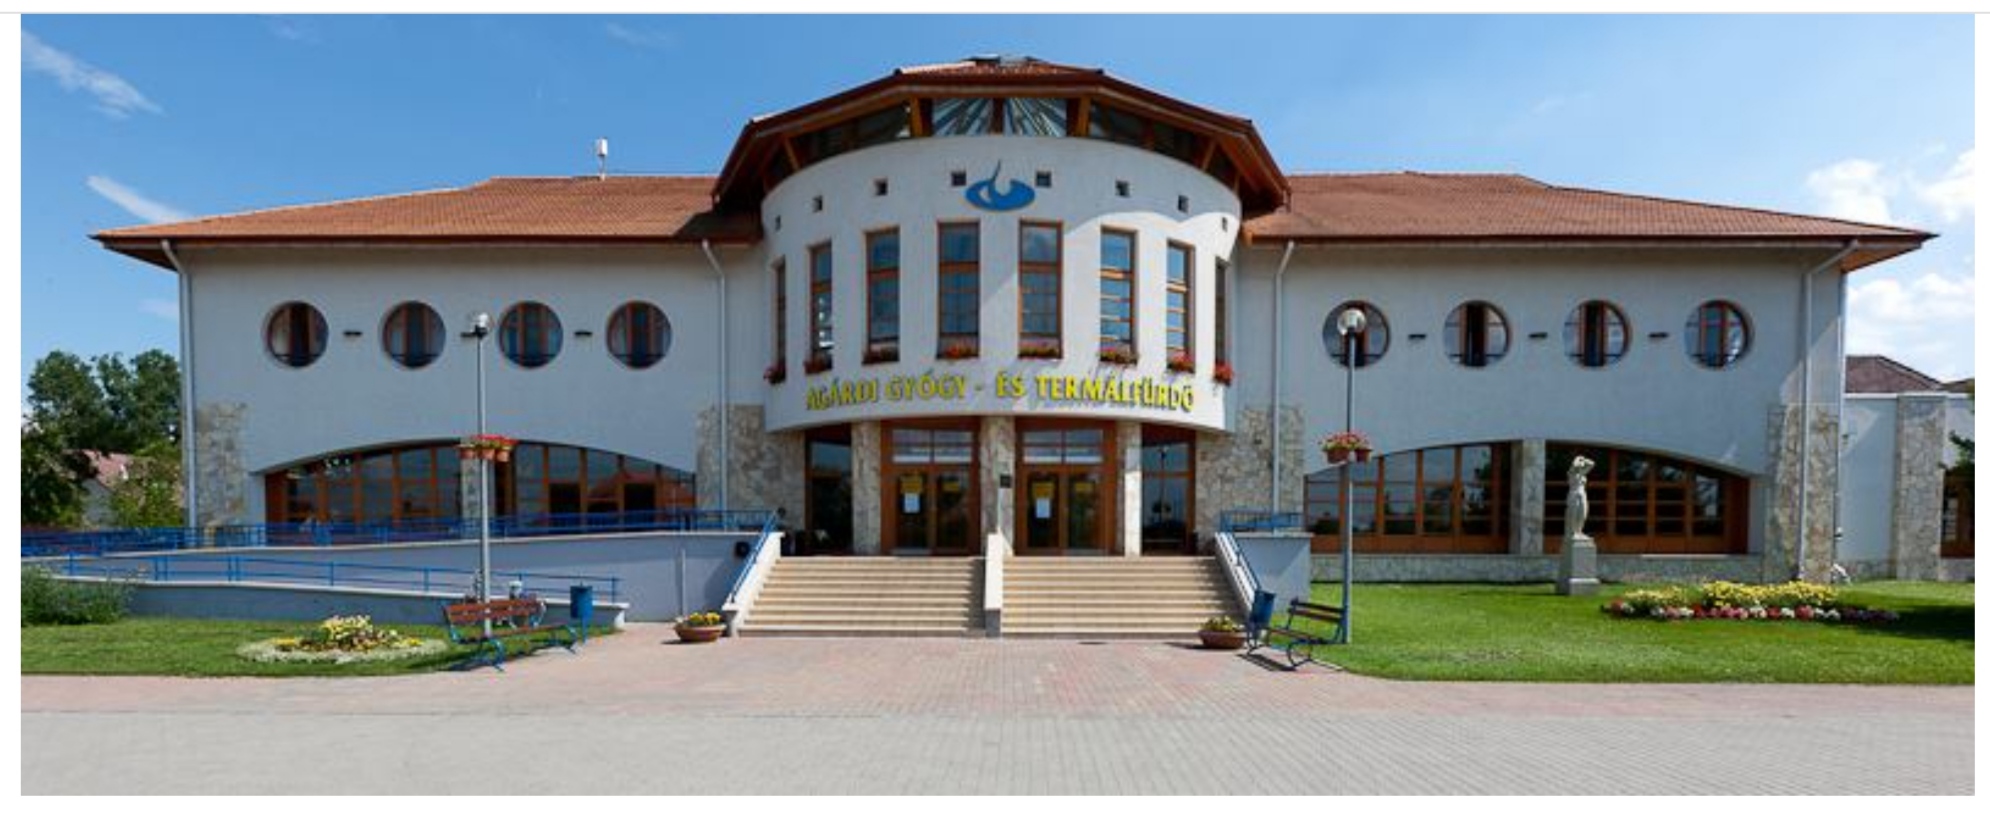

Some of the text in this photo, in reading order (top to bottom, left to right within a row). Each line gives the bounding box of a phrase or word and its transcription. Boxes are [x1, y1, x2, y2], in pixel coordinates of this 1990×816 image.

[806, 377, 879, 411] AGÁRDI
[884, 369, 966, 399] GYÓGY
[995, 371, 1026, 397] ÉS
